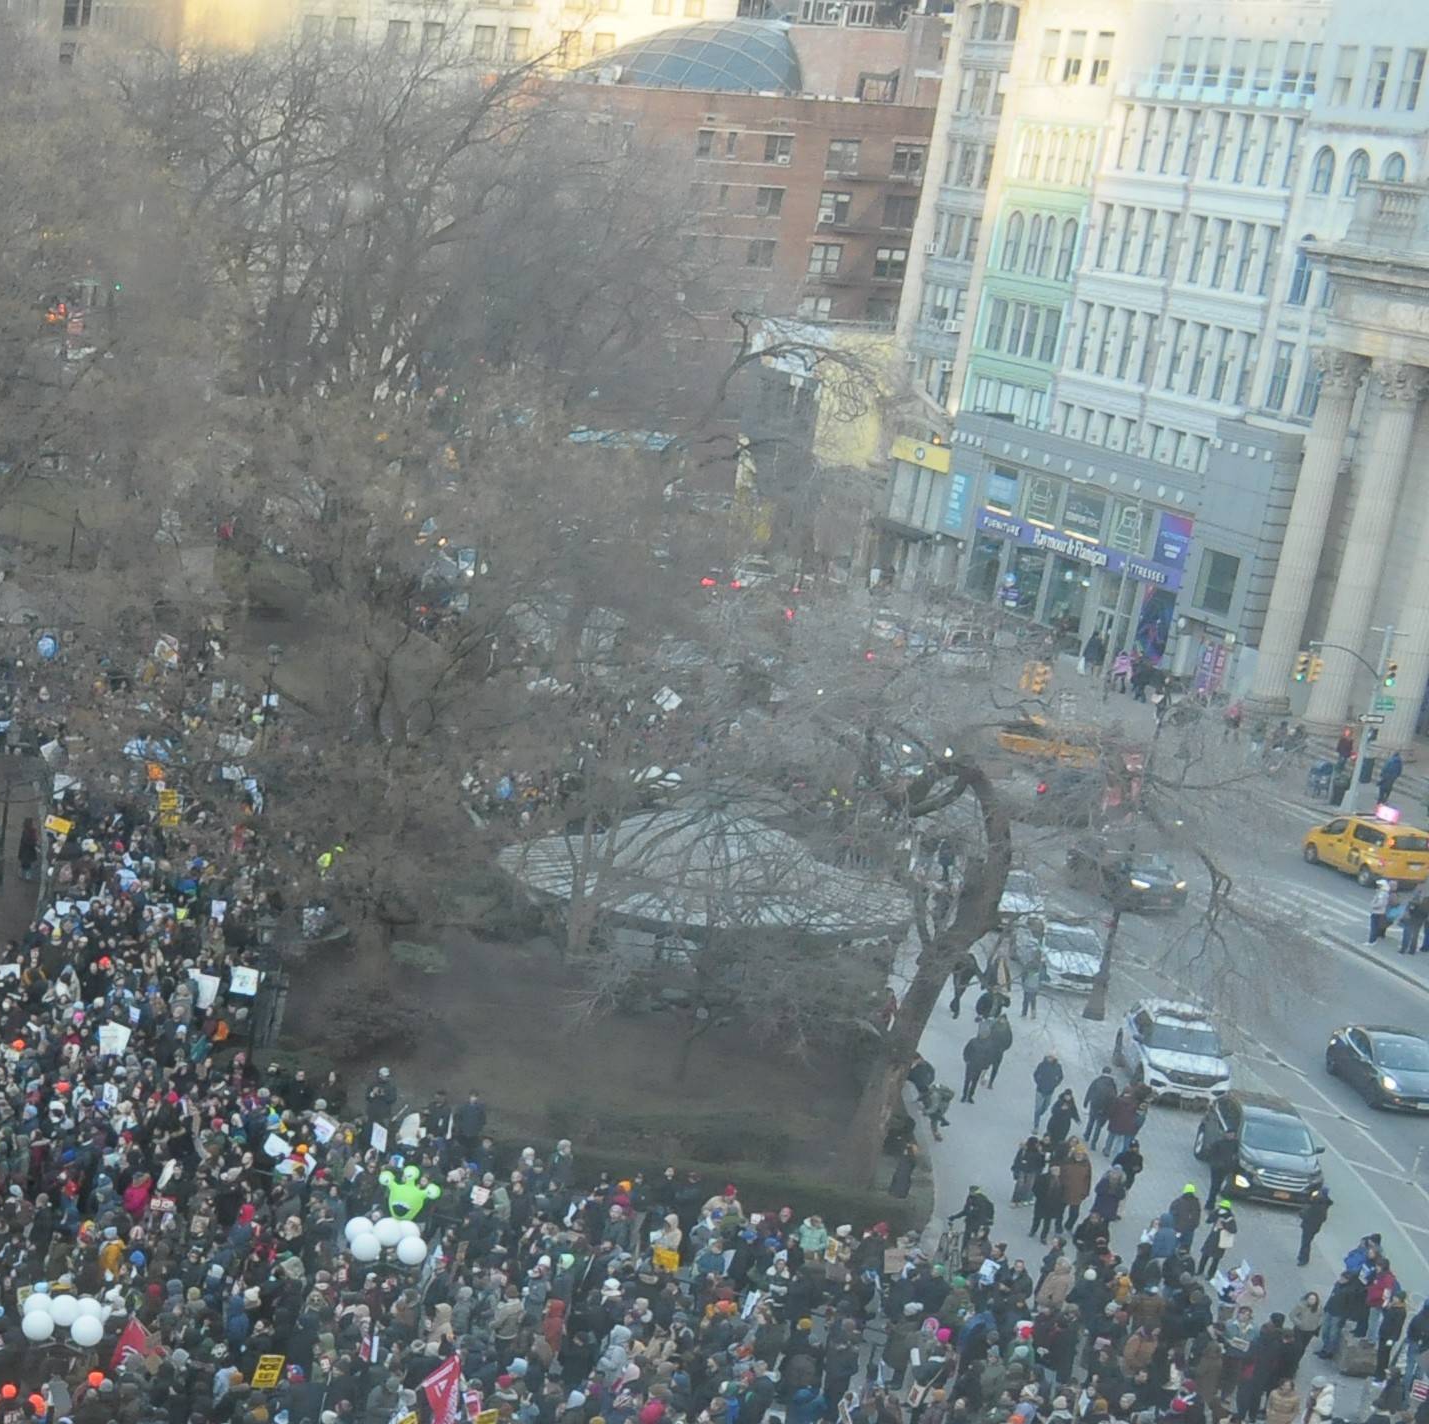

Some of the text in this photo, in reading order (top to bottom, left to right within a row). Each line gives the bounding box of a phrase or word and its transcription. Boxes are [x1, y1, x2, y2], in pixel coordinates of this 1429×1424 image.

[983, 516, 1021, 537] FURNITURE
[1033, 528, 1067, 556] Raymour
[1075, 541, 1107, 566] Flanigan
[1119, 561, 1166, 583] MTTRESSES
